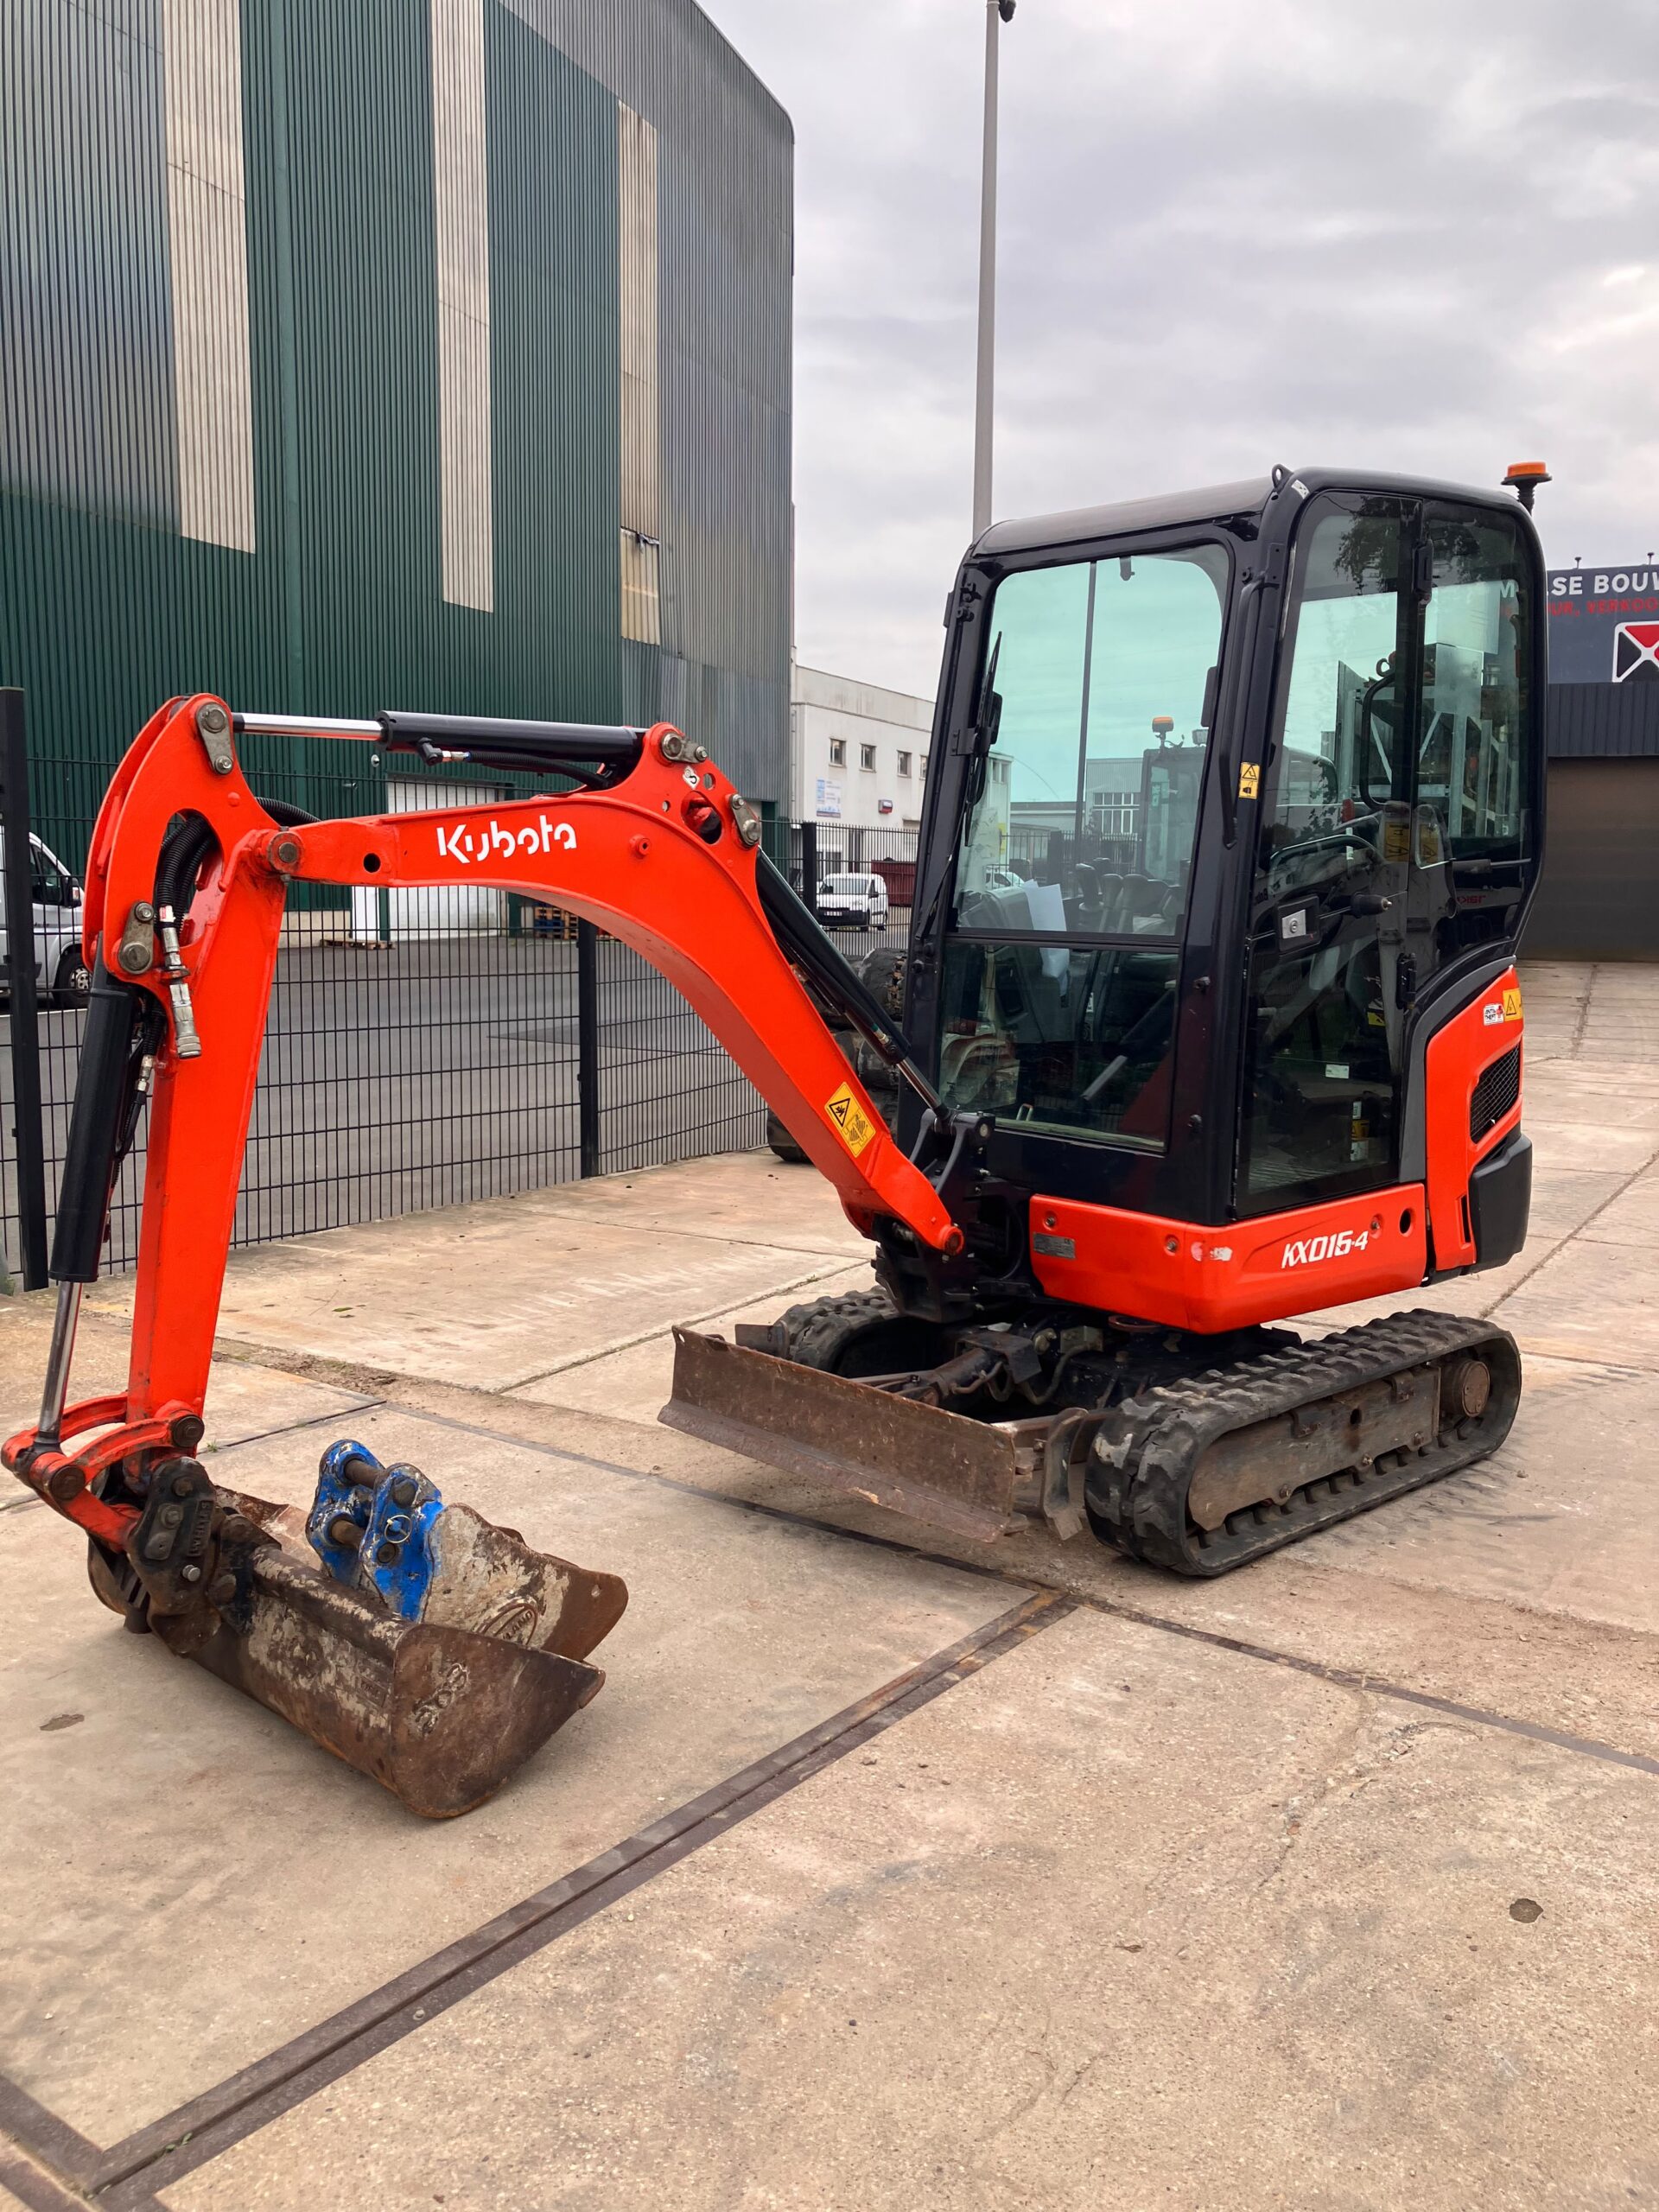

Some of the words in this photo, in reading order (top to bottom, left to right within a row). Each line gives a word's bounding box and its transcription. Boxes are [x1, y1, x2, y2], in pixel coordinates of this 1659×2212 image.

[436, 815, 576, 863] Kubota
[1281, 1230, 1369, 1269] KX016-4
[503, 1611, 533, 1639] LAND
